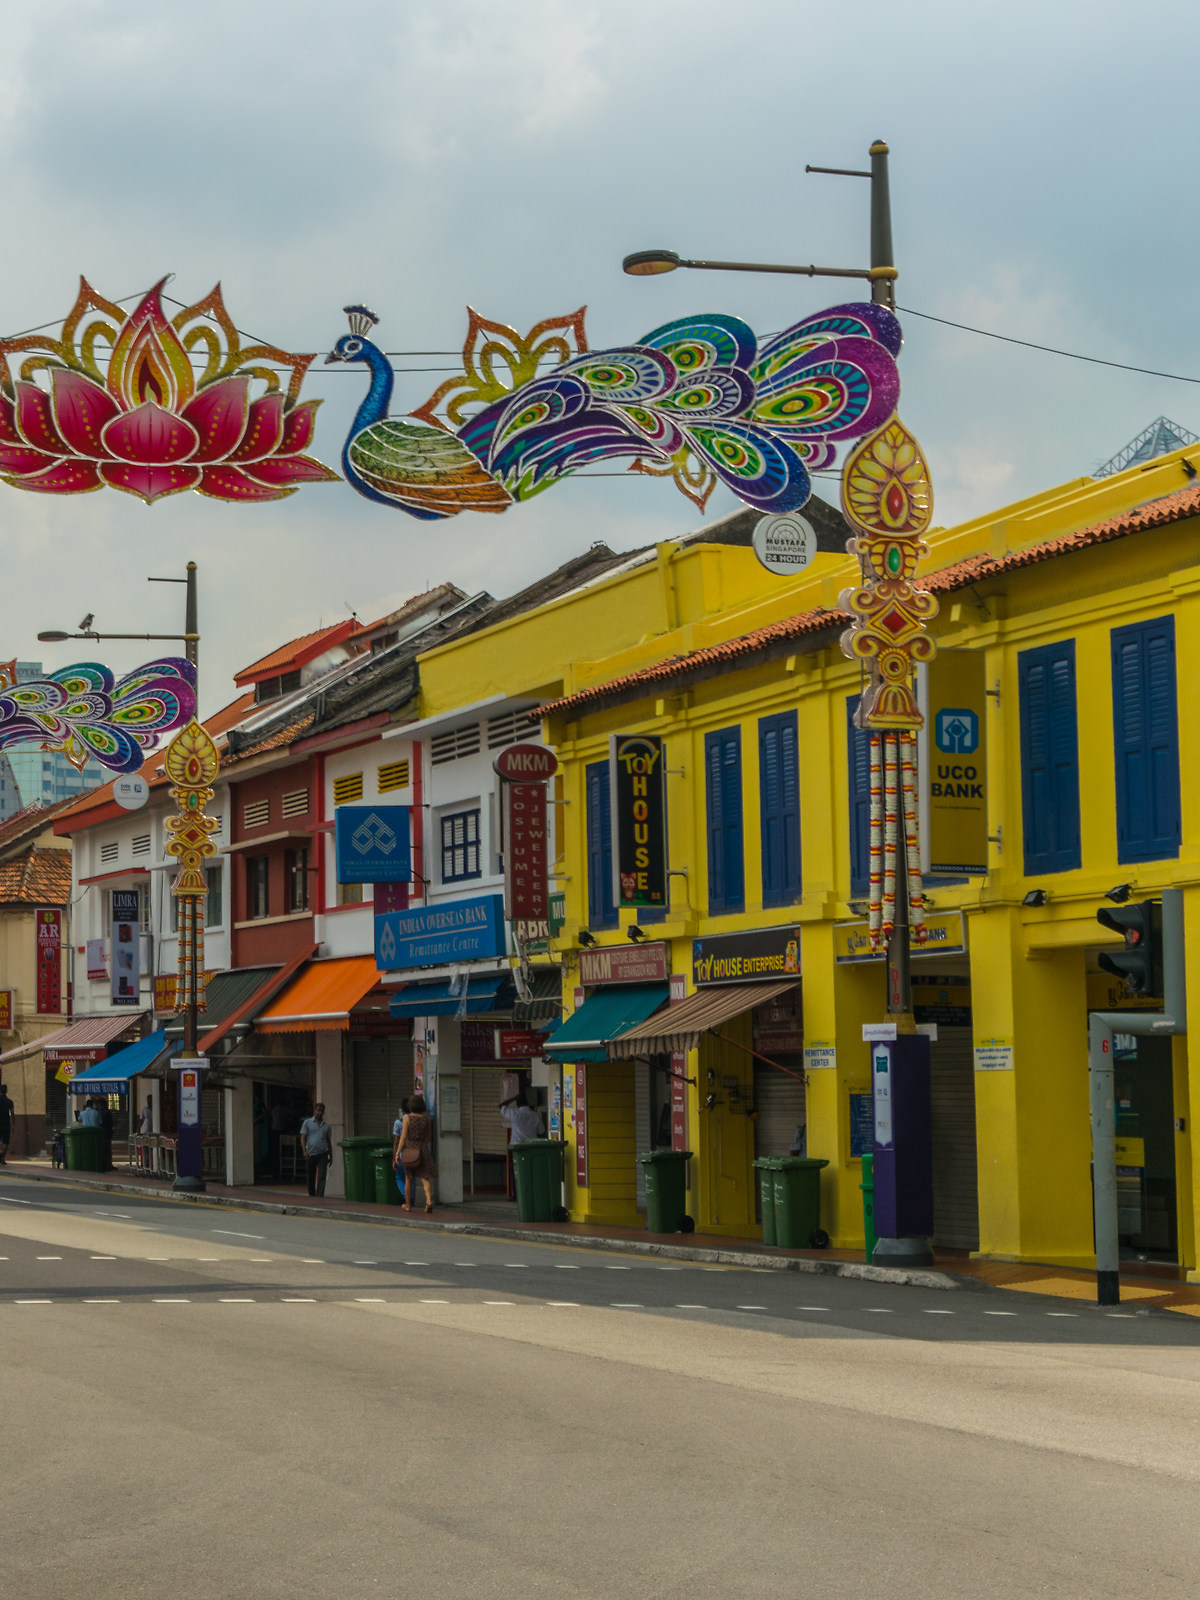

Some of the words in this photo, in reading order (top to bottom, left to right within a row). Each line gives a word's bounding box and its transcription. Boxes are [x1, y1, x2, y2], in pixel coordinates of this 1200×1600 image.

[779, 555, 806, 563] HOUR
[507, 753, 548, 771] MKM
[618, 750, 660, 775] TOY
[938, 765, 977, 780] UCO
[931, 783, 984, 799] BANK
[513, 787, 528, 886] COSTUME
[632, 776, 650, 891] HOUSE
[529, 804, 544, 916] JEWELLERY
[114, 895, 137, 907] LIMRA
[400, 916, 425, 935] INDIAN
[426, 909, 464, 930] OVERSEAS
[465, 905, 487, 924] BANK
[40, 924, 59, 938] AR
[918, 928, 937, 941] ANK
[409, 942, 450, 958] Remittance
[452, 936, 479, 952] Centre
[581, 953, 611, 980] MKM
[694, 954, 714, 981] TOY
[714, 957, 742, 978] HOUSE
[743, 955, 784, 973] ENTERPRISE
[671, 982, 684, 999] MKM
[805, 1048, 835, 1057] REMITTANCE
[1102, 1040, 1109, 1053] 6
[811, 1058, 830, 1067] CENTER
